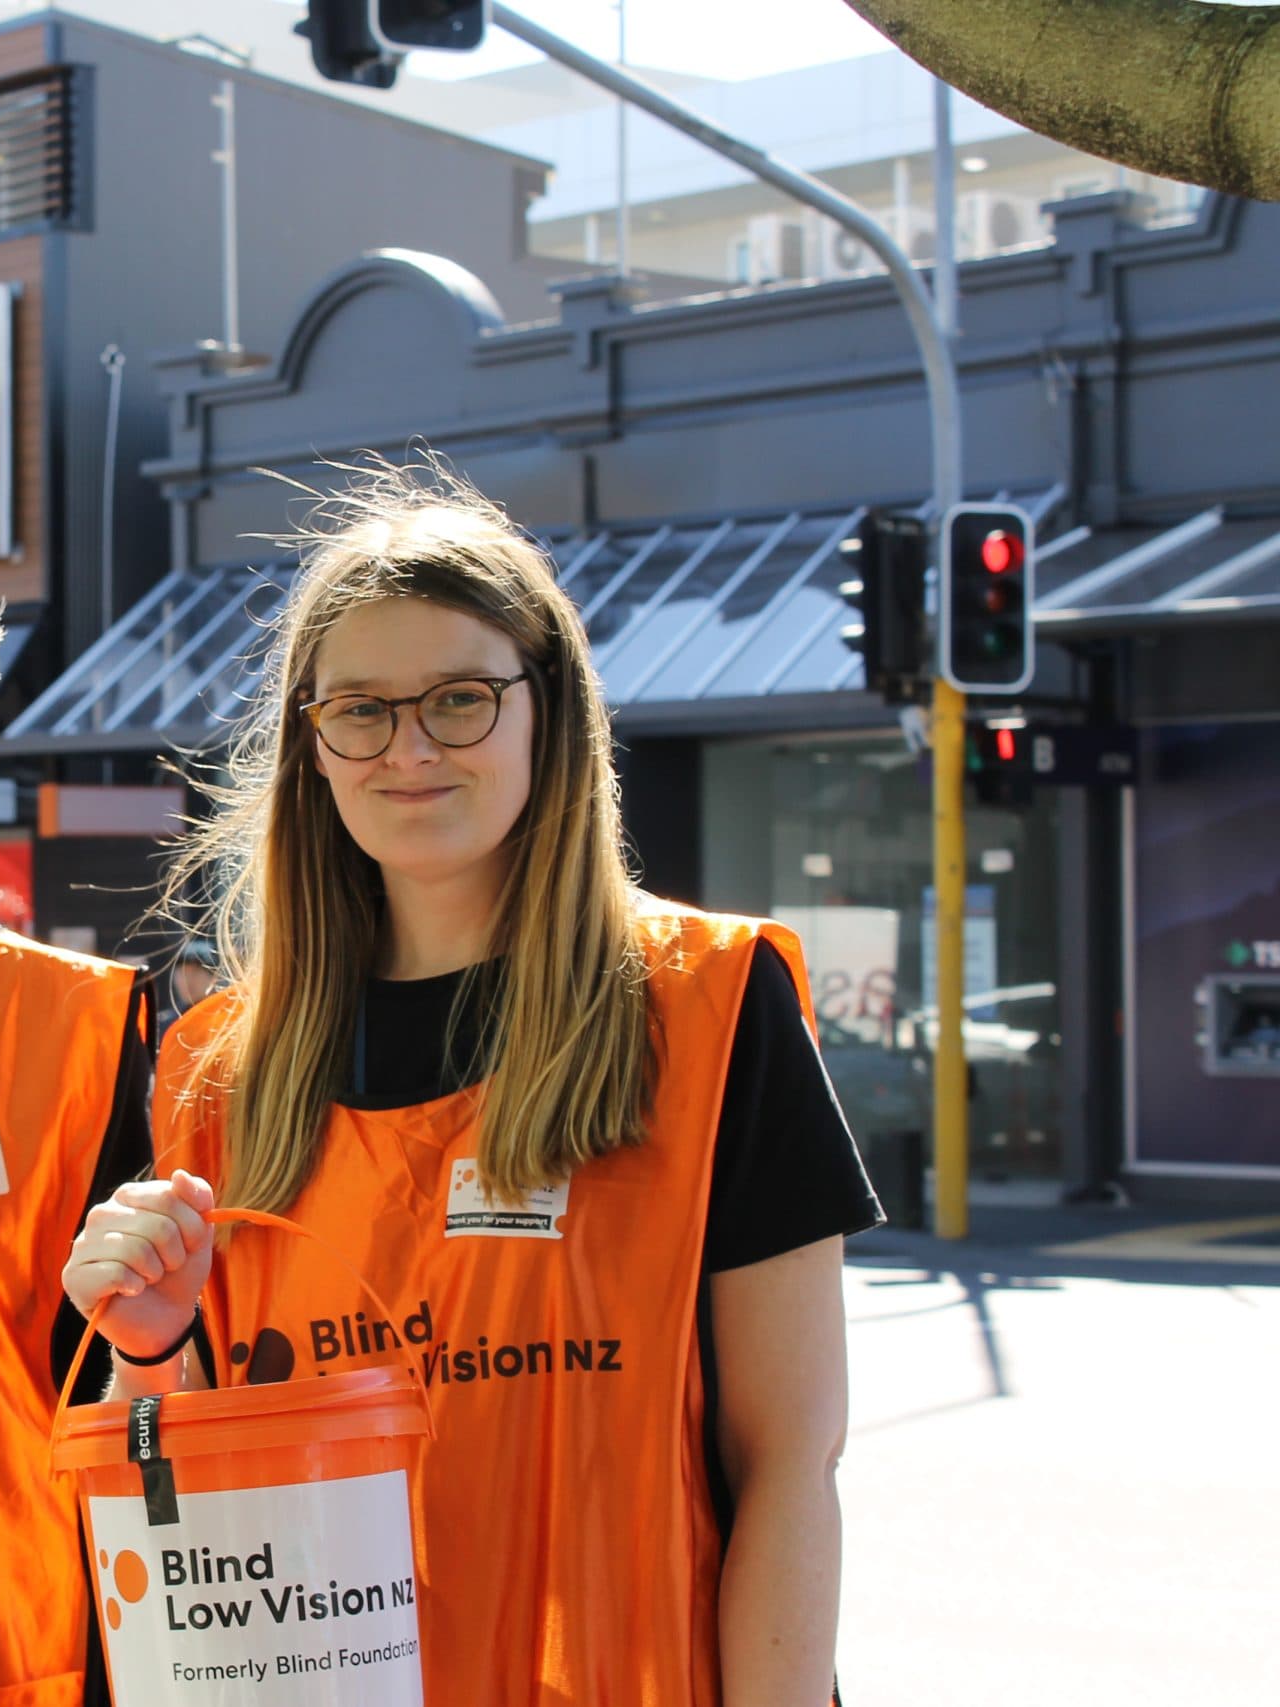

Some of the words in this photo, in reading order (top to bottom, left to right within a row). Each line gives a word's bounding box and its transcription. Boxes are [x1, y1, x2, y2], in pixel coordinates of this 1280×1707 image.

[310, 1301, 433, 1362] Blind
[421, 1336, 552, 1388] Vision
[564, 1339, 622, 1371] NZ
[161, 1543, 274, 1586] Blind
[166, 1595, 252, 1630] Low
[260, 1580, 385, 1623] Vision
[391, 1578, 414, 1607] NZ
[173, 1659, 267, 1682] Formerly
[277, 1651, 332, 1675] Blind
[339, 1639, 418, 1668] Foundation
